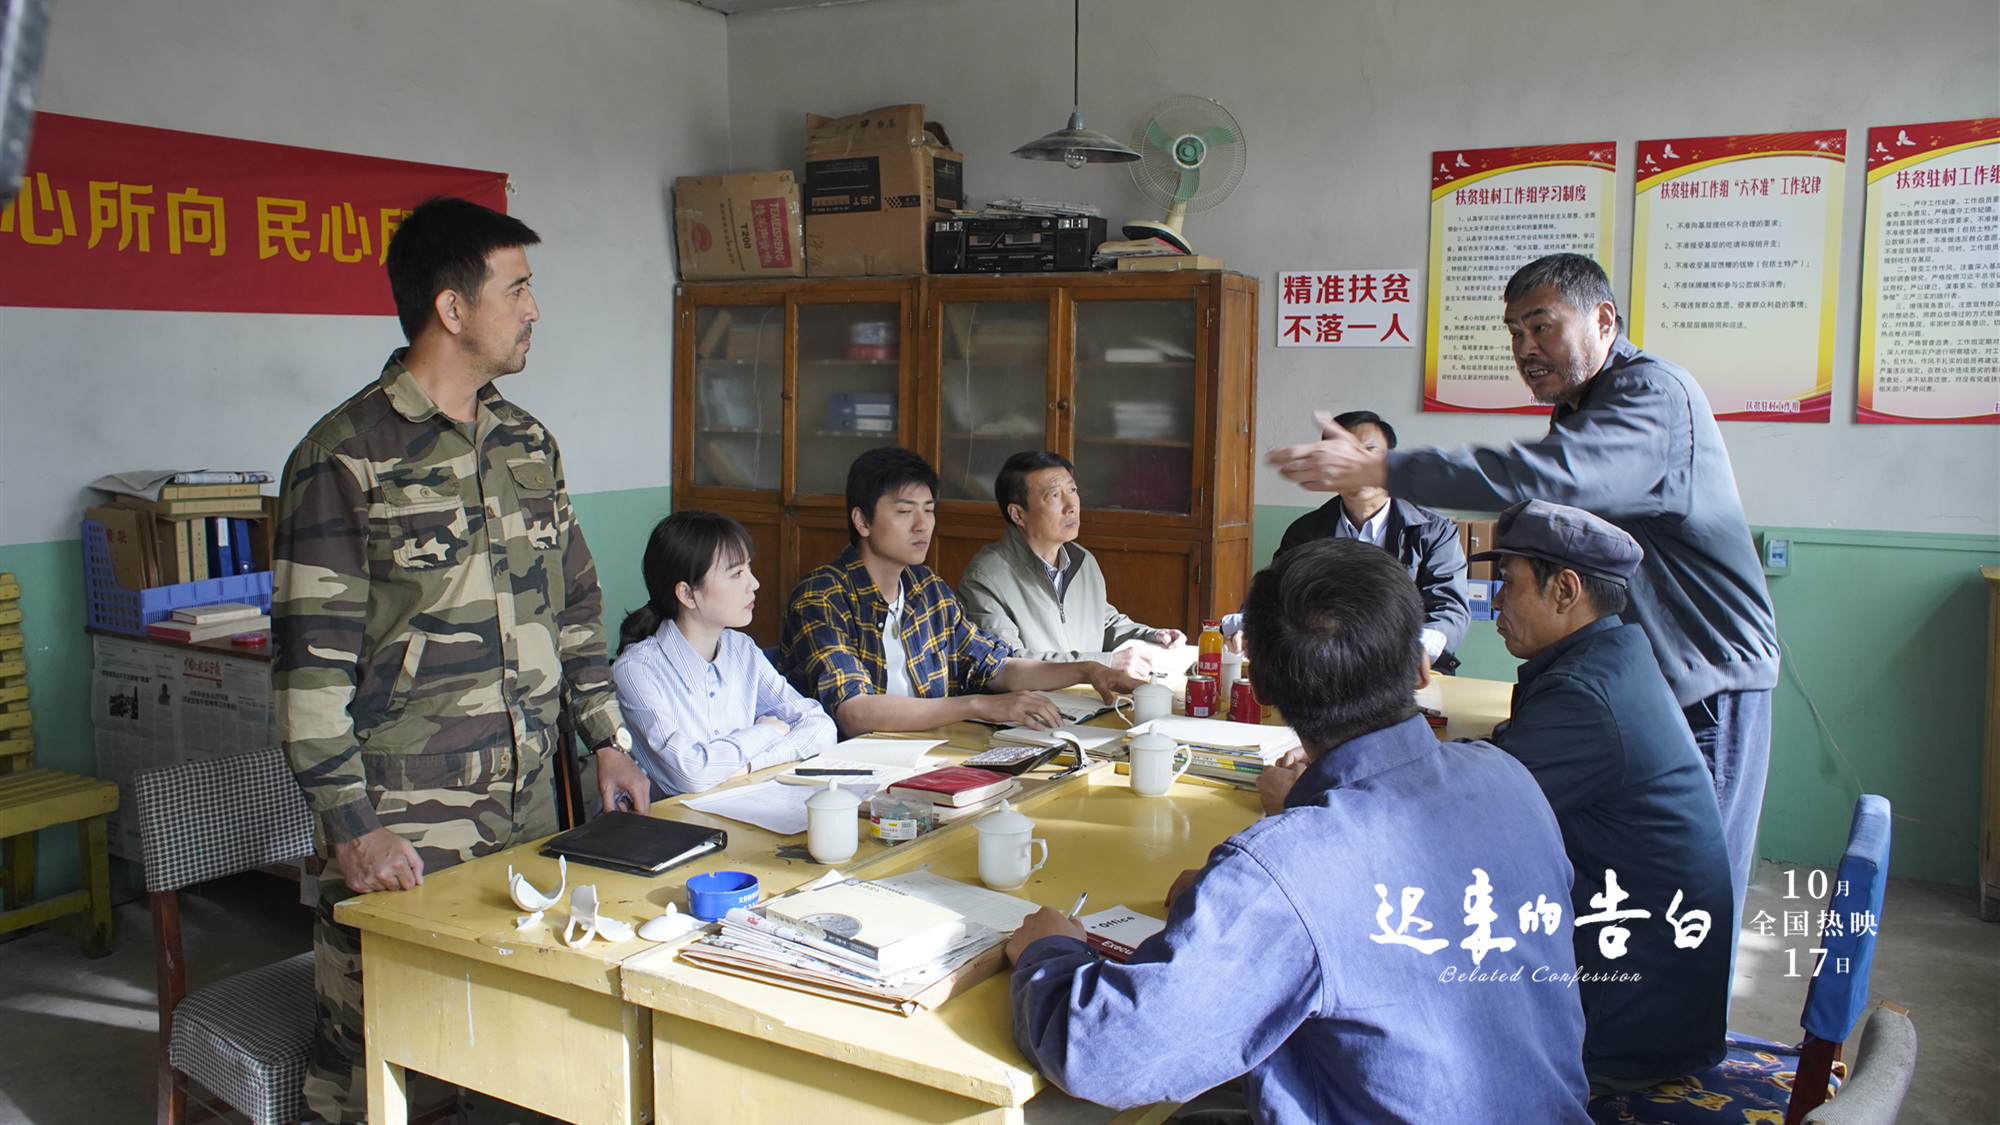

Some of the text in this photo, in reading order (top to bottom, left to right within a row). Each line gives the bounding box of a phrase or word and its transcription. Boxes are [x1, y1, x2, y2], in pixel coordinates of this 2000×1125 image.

[1896, 164, 2000, 190] 扶贫驻村工作组
[1660, 176, 1822, 200] 扶贫驻村工作组“六不准”工作纪律
[852, 195, 875, 206] JST
[1455, 185, 1587, 206] 扶贫驻村工作组学习制度
[1666, 219, 1782, 230] 1、不准向基层提任何不合理的要求；
[738, 222, 751, 250] T200
[769, 202, 785, 262] TEMEISHENG
[1664, 240, 1781, 250] 2、不准接受基层的吃请和报销开支；
[1446, 264, 1524, 272] ，特别是广大农民群众十分关注
[1283, 273, 1411, 305] 精准扶贫
[1283, 312, 1410, 343] 不落一人
[1660, 320, 1748, 330] 6、不准层层搞陪同和迎送。
[1453, 344, 1512, 352] 5、每周要求集中一个晚
[1880, 347, 2000, 356] ，深入村组和农户进行明察暗访。对工
[1879, 366, 2000, 374] 严重违反规定，在群众中造成恶劣的影
[1745, 400, 1801, 413] 扶贫驻村工作组
[1099, 915, 1136, 928] Office
